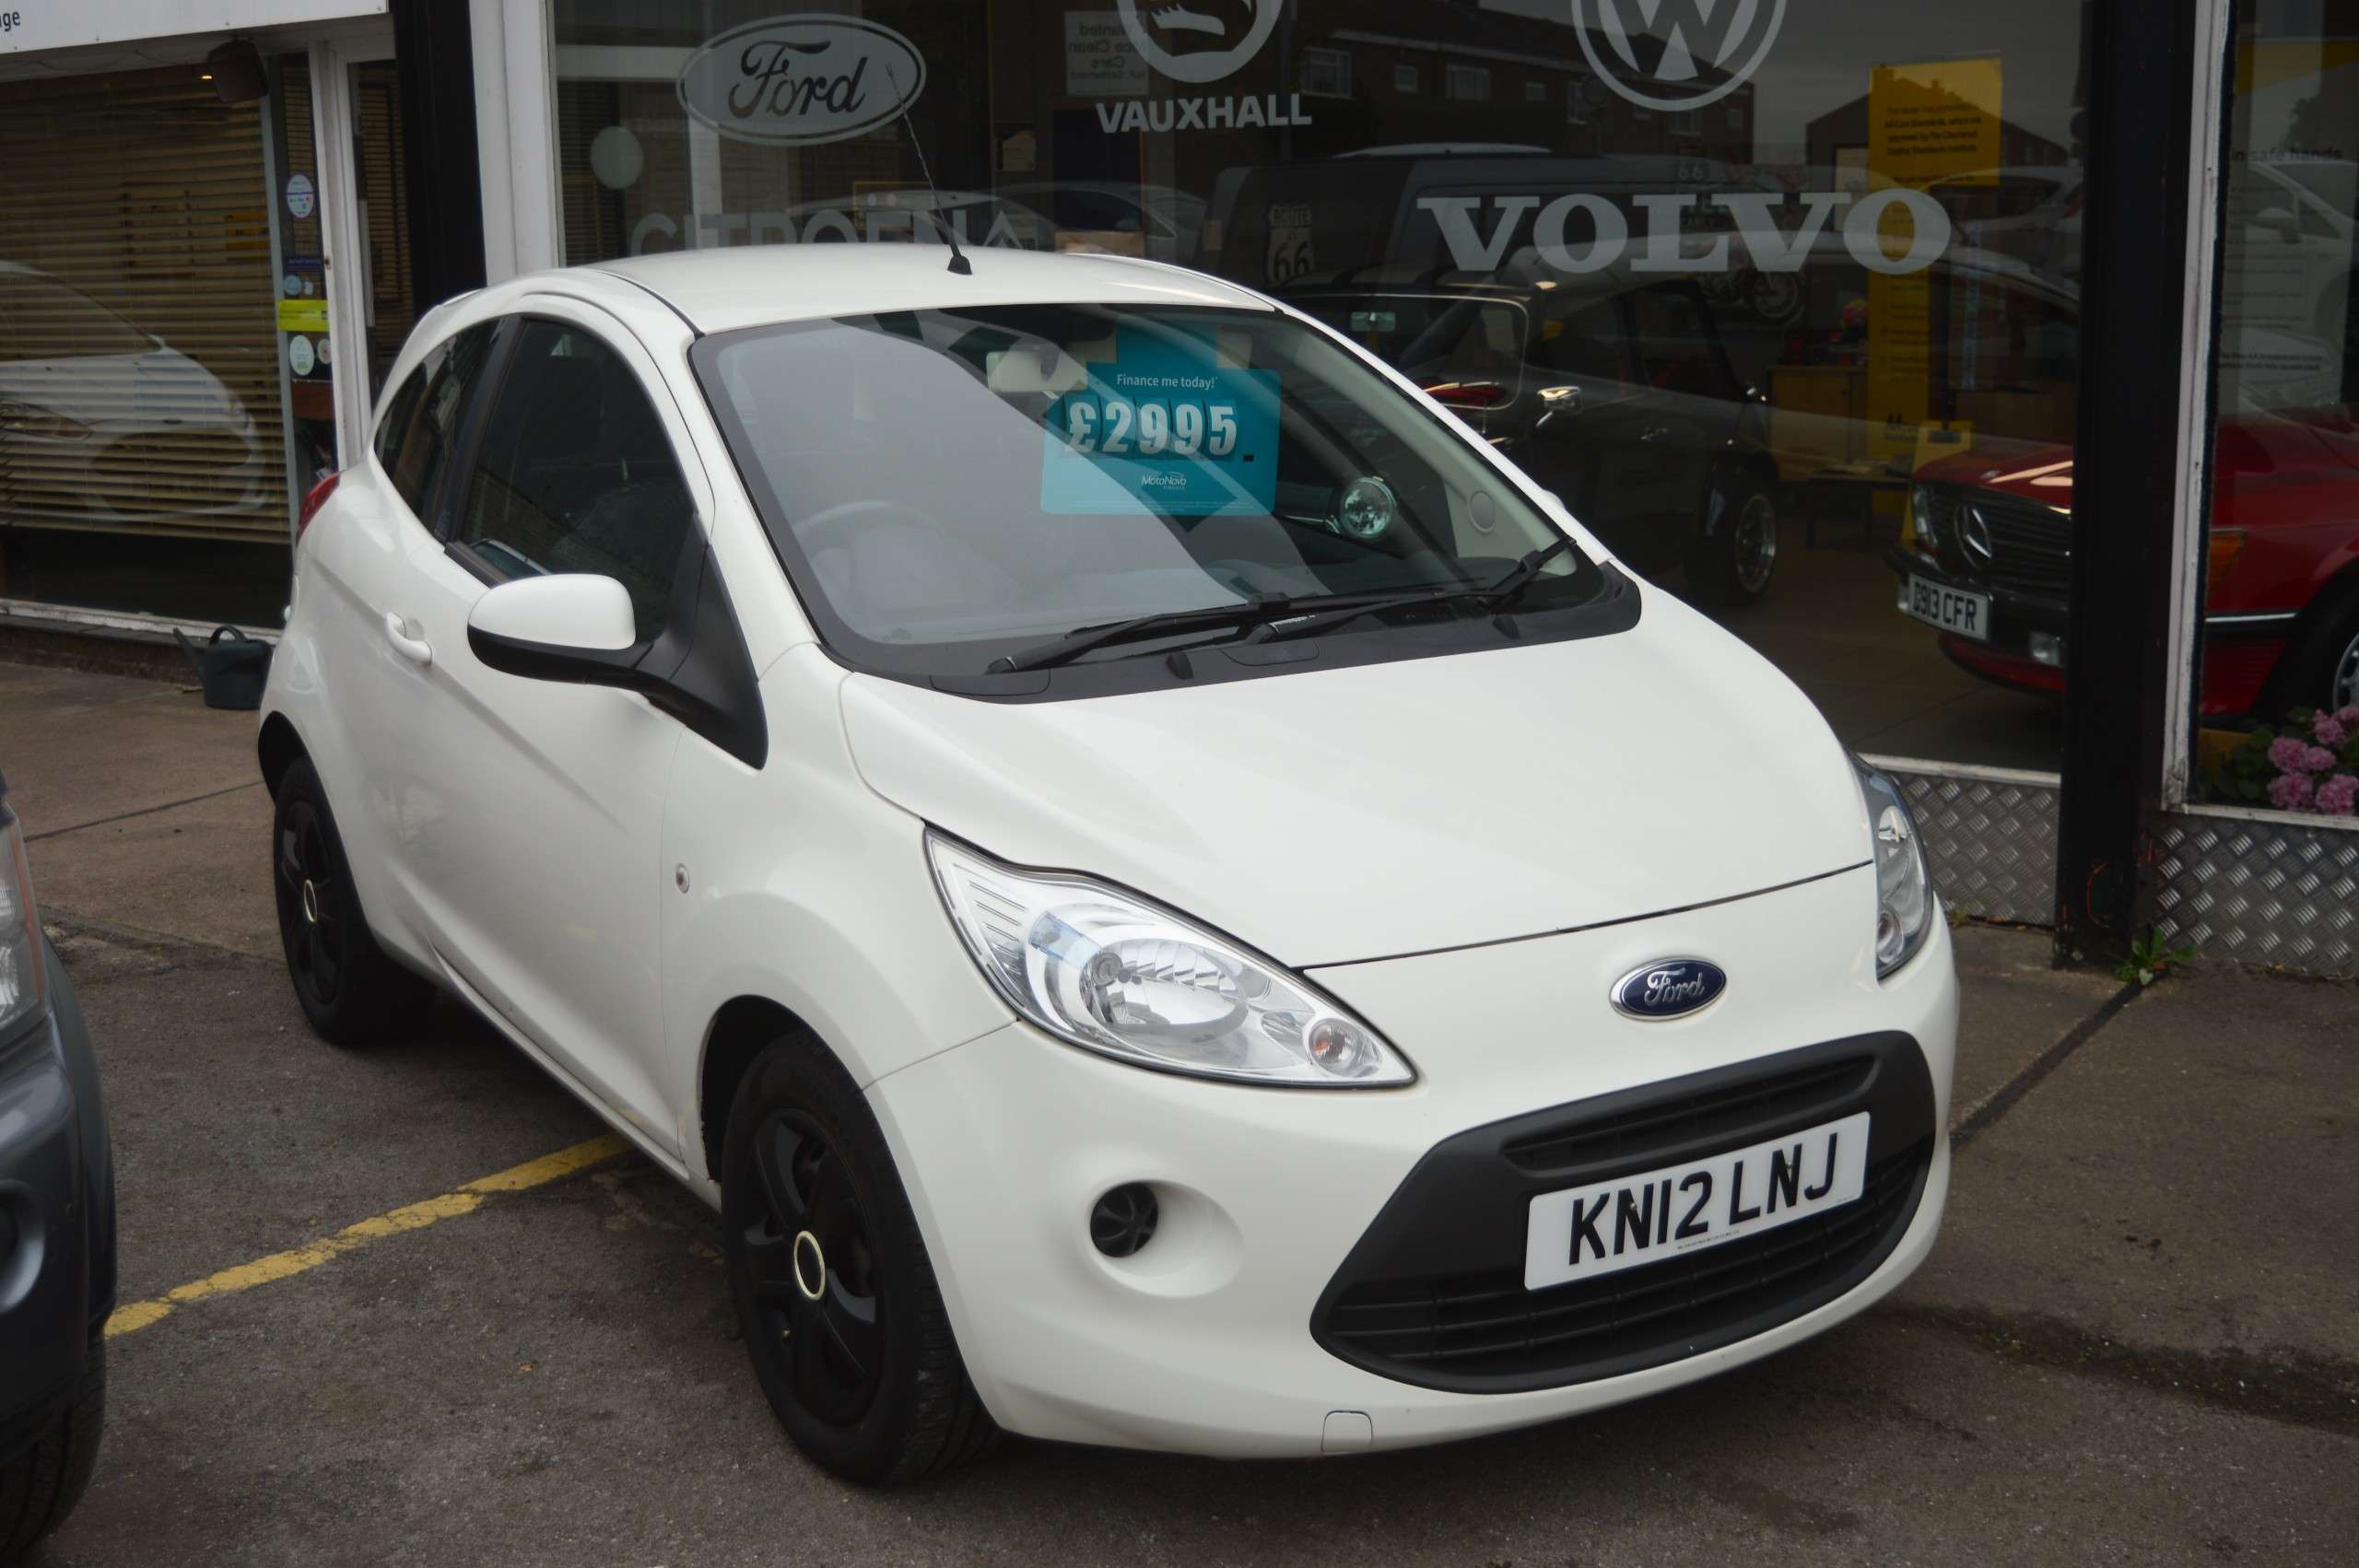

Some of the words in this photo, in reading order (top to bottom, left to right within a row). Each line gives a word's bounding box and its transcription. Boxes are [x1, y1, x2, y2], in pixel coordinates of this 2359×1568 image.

[0, 11, 21, 32] ge
[727, 40, 867, 118] Ford
[1096, 93, 1313, 133] VAUXHALL
[2249, 146, 2286, 162] safe
[1416, 188, 1952, 274] VOLVO
[1273, 240, 1309, 280] 66
[1117, 373, 1159, 387] Finance
[1162, 378, 1179, 387] me
[1065, 401, 1238, 456] £2995
[1942, 592, 1977, 632] CFR
[1644, 967, 1705, 1007] Ford
[1568, 1171, 1713, 1266] KN12
[1729, 1132, 1837, 1226] LNJ
